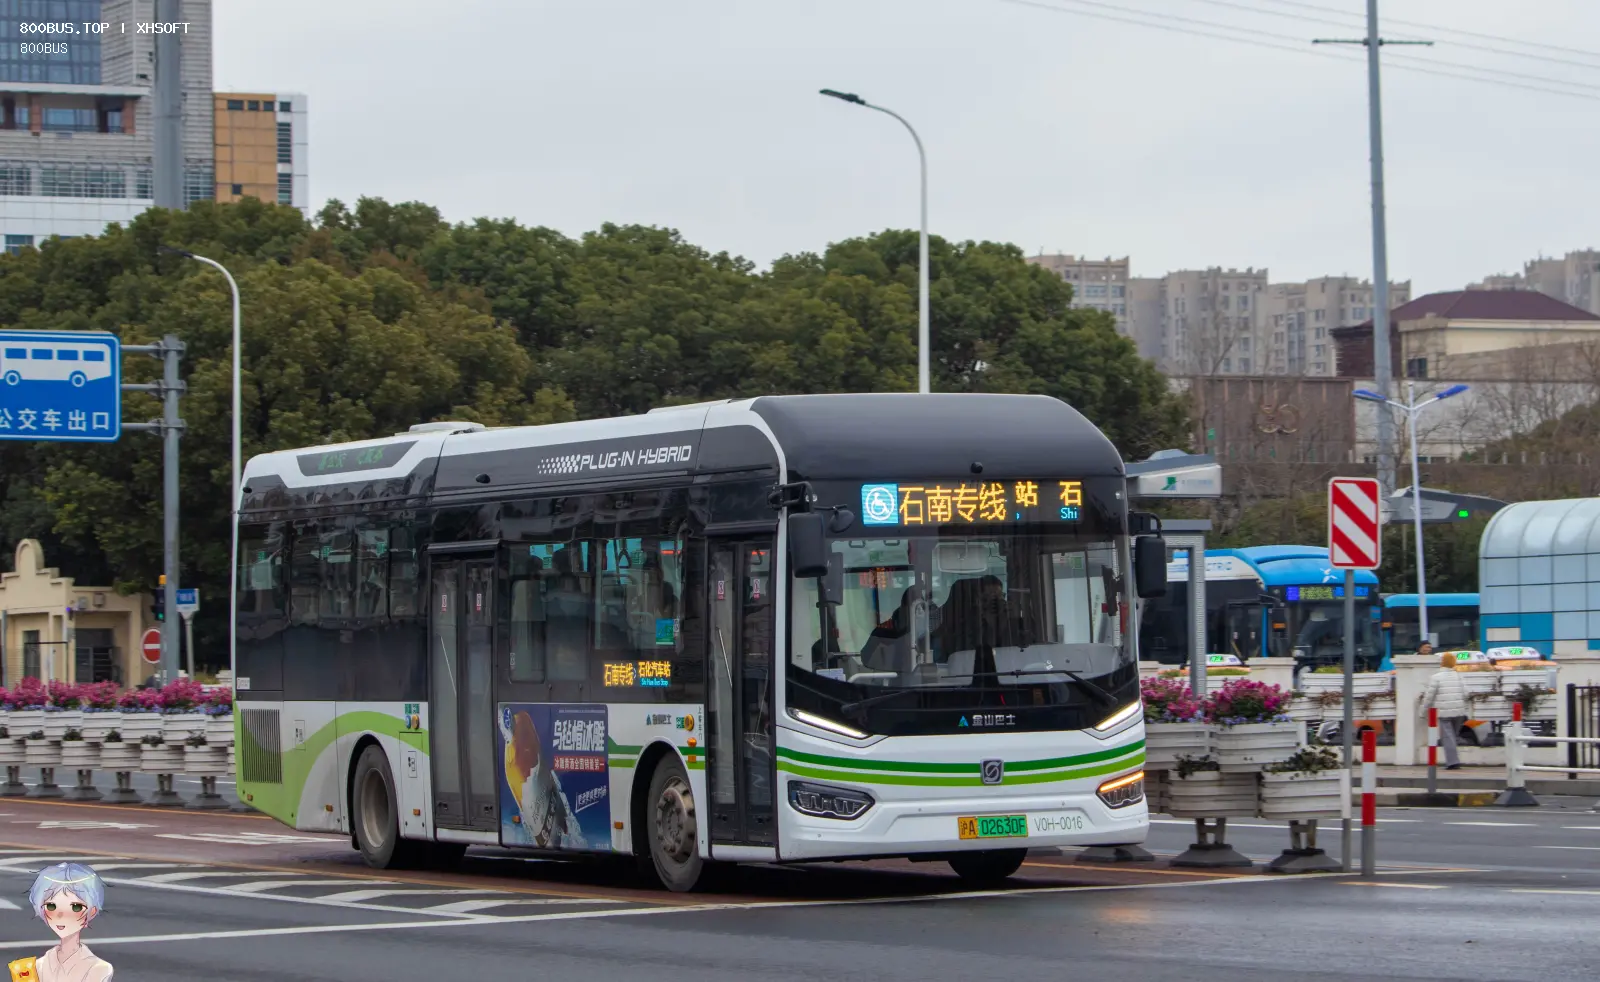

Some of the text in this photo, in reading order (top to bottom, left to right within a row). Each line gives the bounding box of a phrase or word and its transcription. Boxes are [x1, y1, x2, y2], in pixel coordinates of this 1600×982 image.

[0, 408, 109, 431] 公交车出口
[580, 445, 692, 471] PLUG-IN HYBRID
[898, 481, 1082, 525] 石南专线 站 石
[1061, 507, 1078, 519] Shi
[972, 714, 1016, 726] 金山巴士
